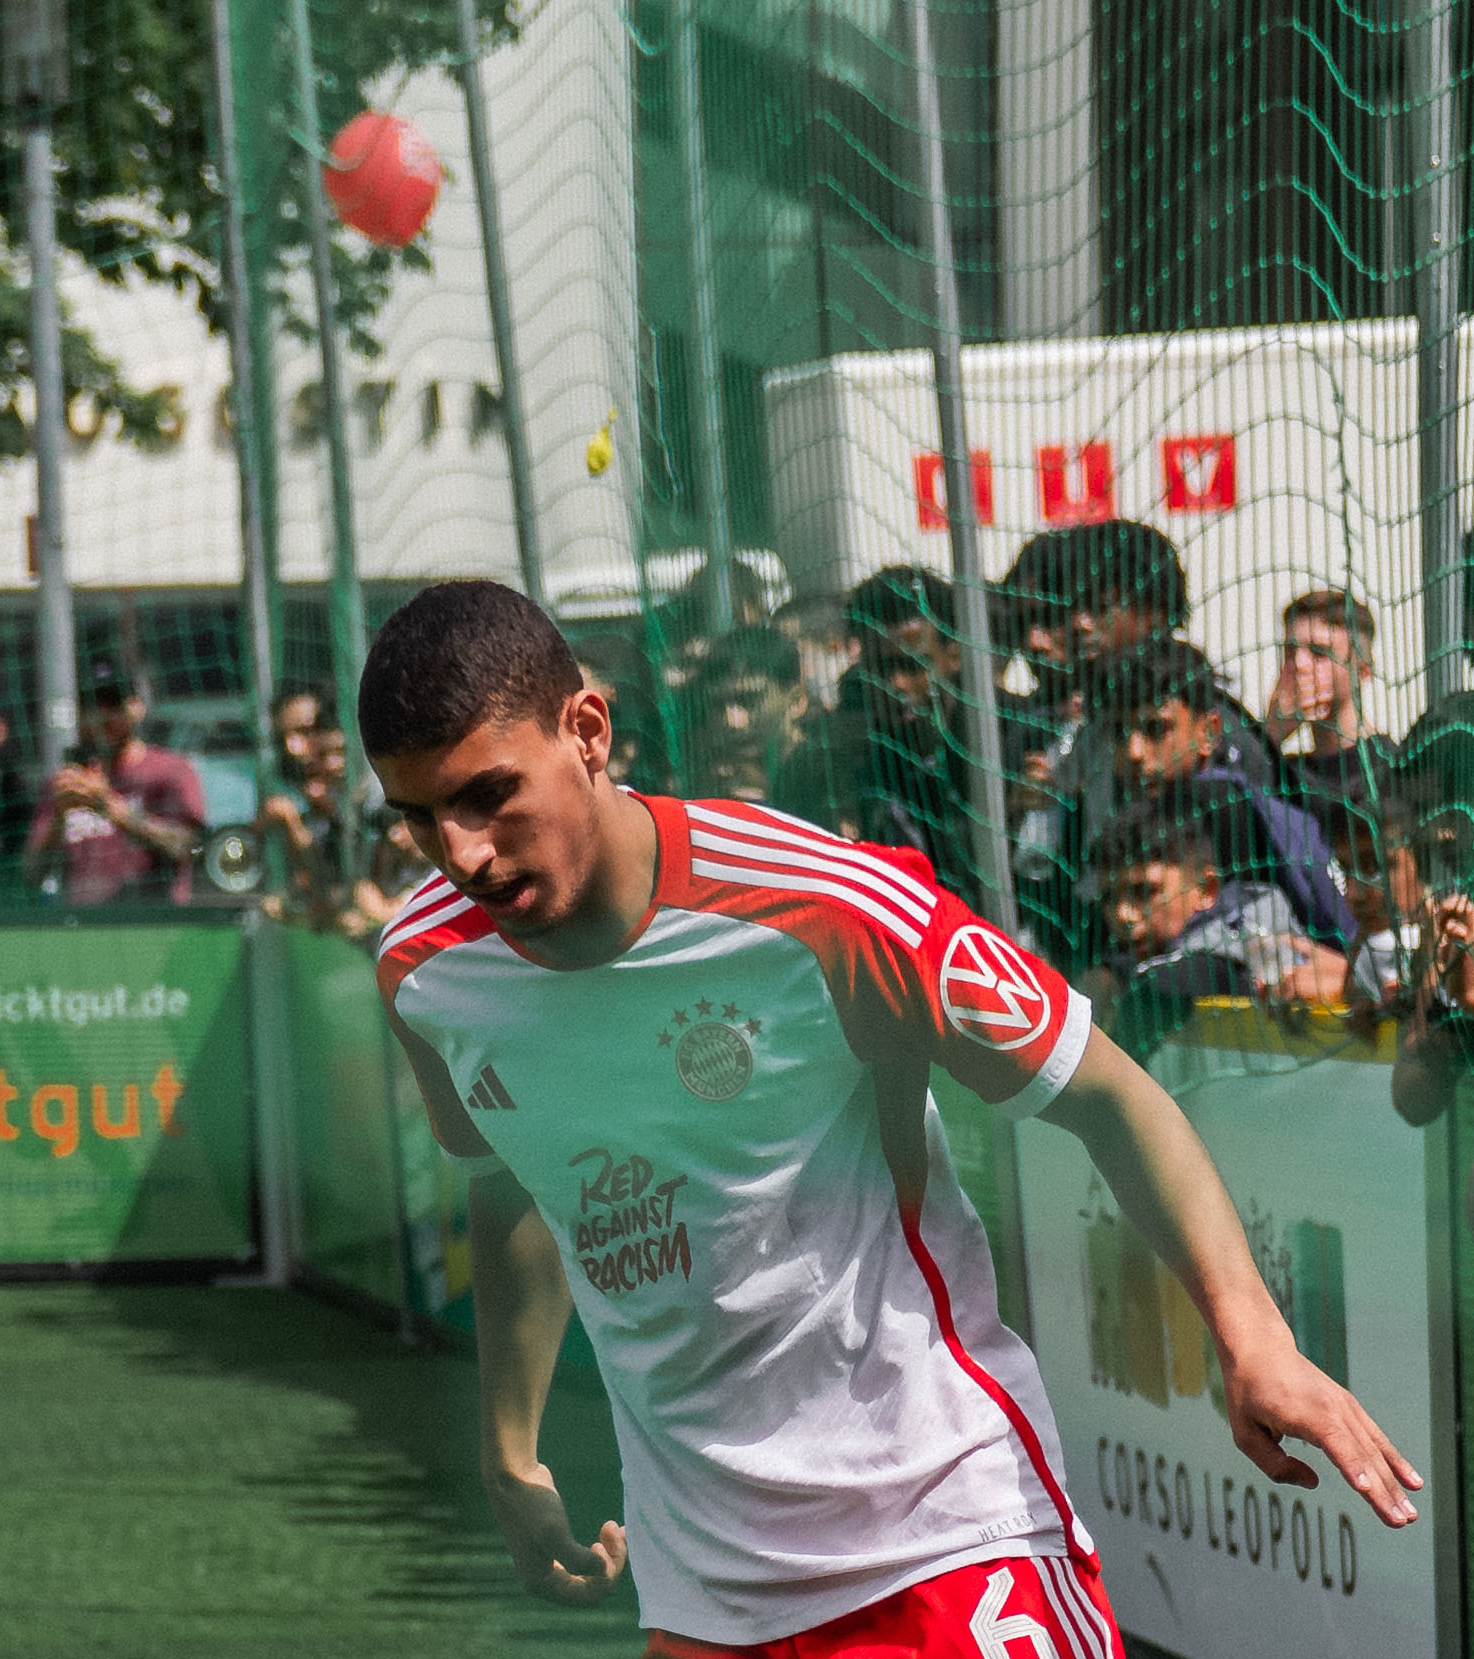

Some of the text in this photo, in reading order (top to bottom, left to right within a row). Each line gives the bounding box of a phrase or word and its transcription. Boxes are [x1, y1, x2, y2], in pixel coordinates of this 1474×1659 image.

[568, 1147, 654, 1214] RED
[576, 1174, 688, 1252] AGAINST
[580, 1221, 692, 1295] RACISM
[1097, 1436, 1359, 1597] CORSO LEOPOLD
